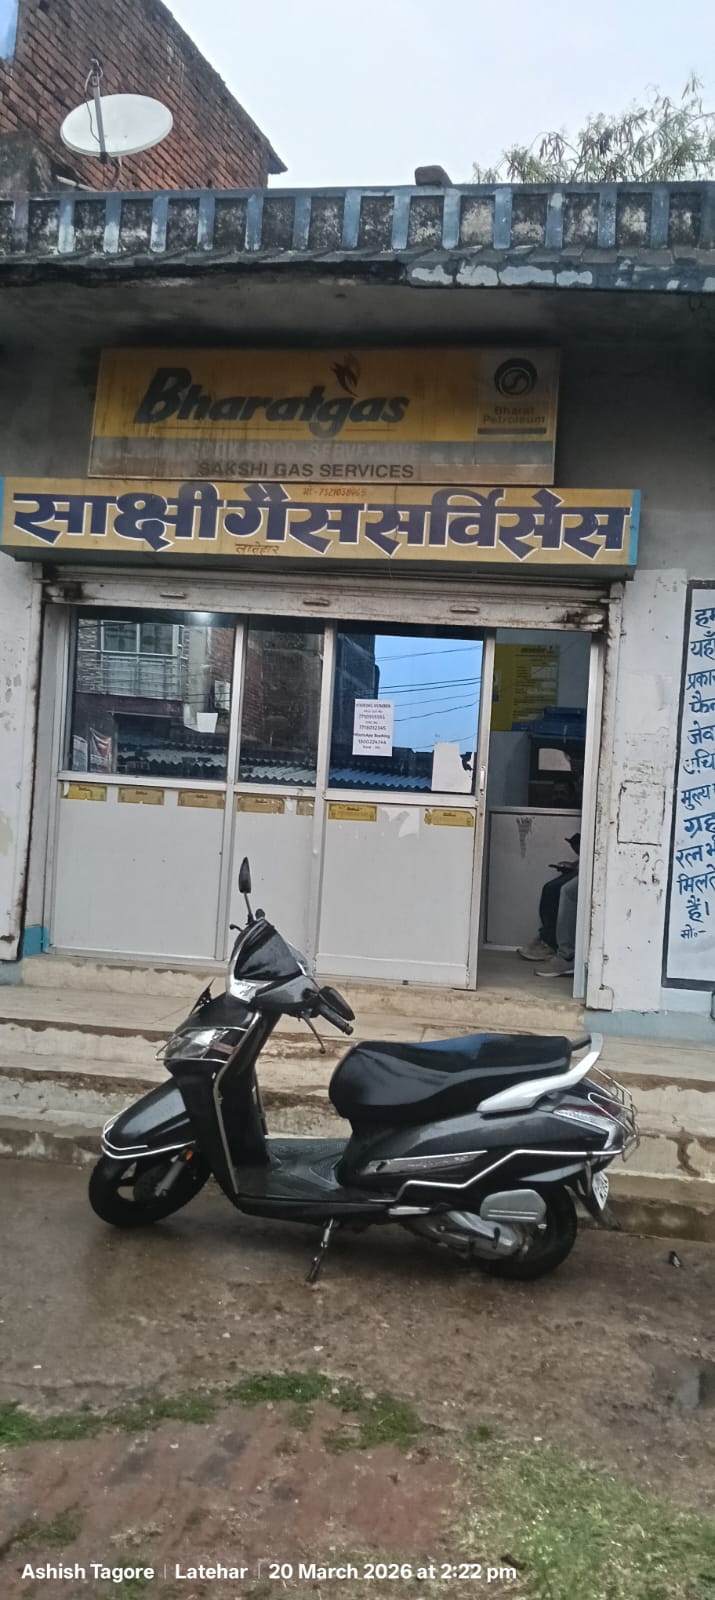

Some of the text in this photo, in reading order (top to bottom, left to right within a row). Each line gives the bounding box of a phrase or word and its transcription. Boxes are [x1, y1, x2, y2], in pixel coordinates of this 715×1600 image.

[133, 367, 411, 438] Bharatgas
[494, 405, 535, 416] Bharat
[482, 415, 545, 426] Petroleum
[199, 461, 414, 478] SAKSHI GAS SERVICES
[13, 483, 632, 560] साक्षी गैस सर्विसेस
[675, 845, 704, 869] रत्न
